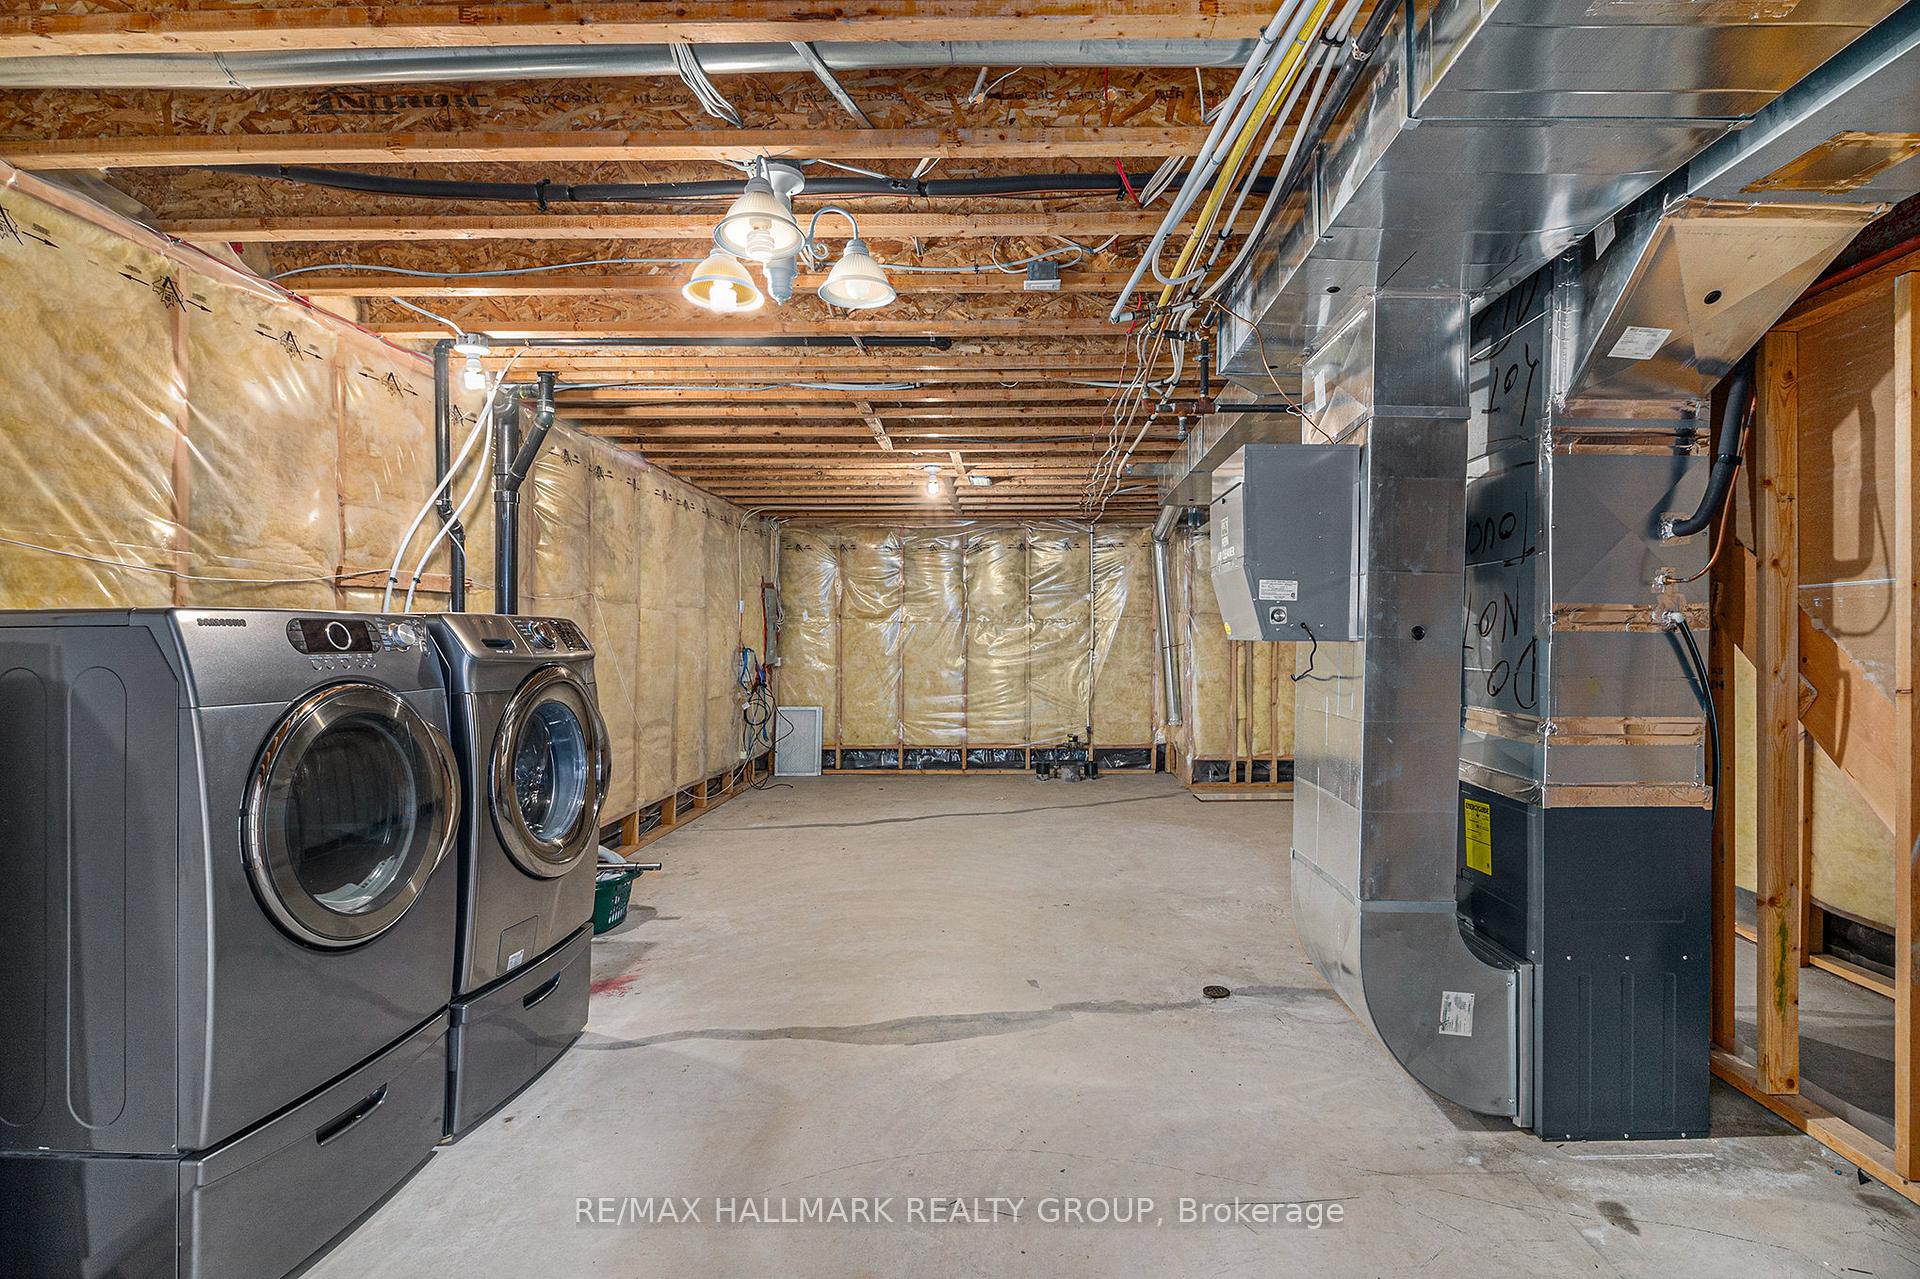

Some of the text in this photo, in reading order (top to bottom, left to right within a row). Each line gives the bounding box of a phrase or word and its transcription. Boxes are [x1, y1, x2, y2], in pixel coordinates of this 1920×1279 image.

[196, 618, 247, 628] SAMSUNG
[1463, 576, 1520, 650] NOT
[1486, 635, 1538, 710] DO
